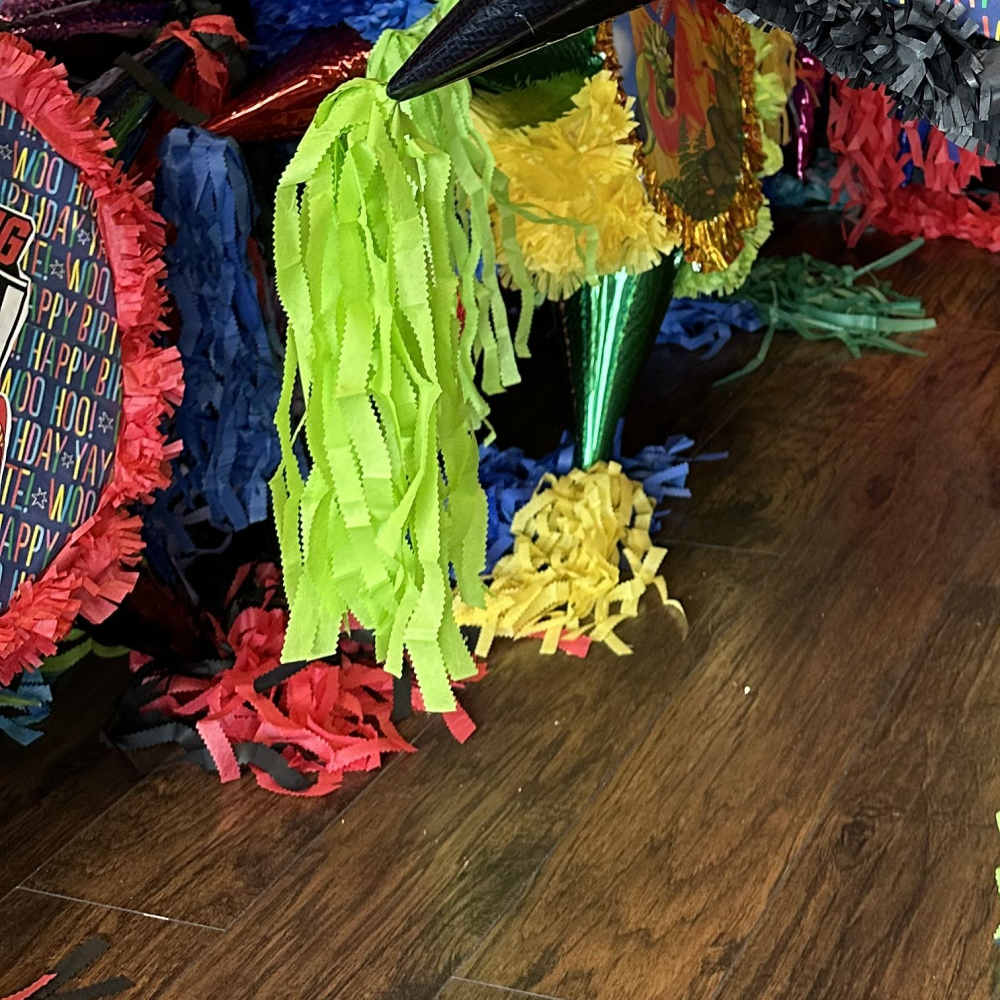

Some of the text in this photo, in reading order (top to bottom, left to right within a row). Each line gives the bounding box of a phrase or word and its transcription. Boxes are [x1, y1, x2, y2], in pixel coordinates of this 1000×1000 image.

[13, 140, 64, 195] WOO
[66, 251, 111, 306] WOO
[27, 328, 96, 391] HAPPY
[49, 385, 98, 439] HOO!
